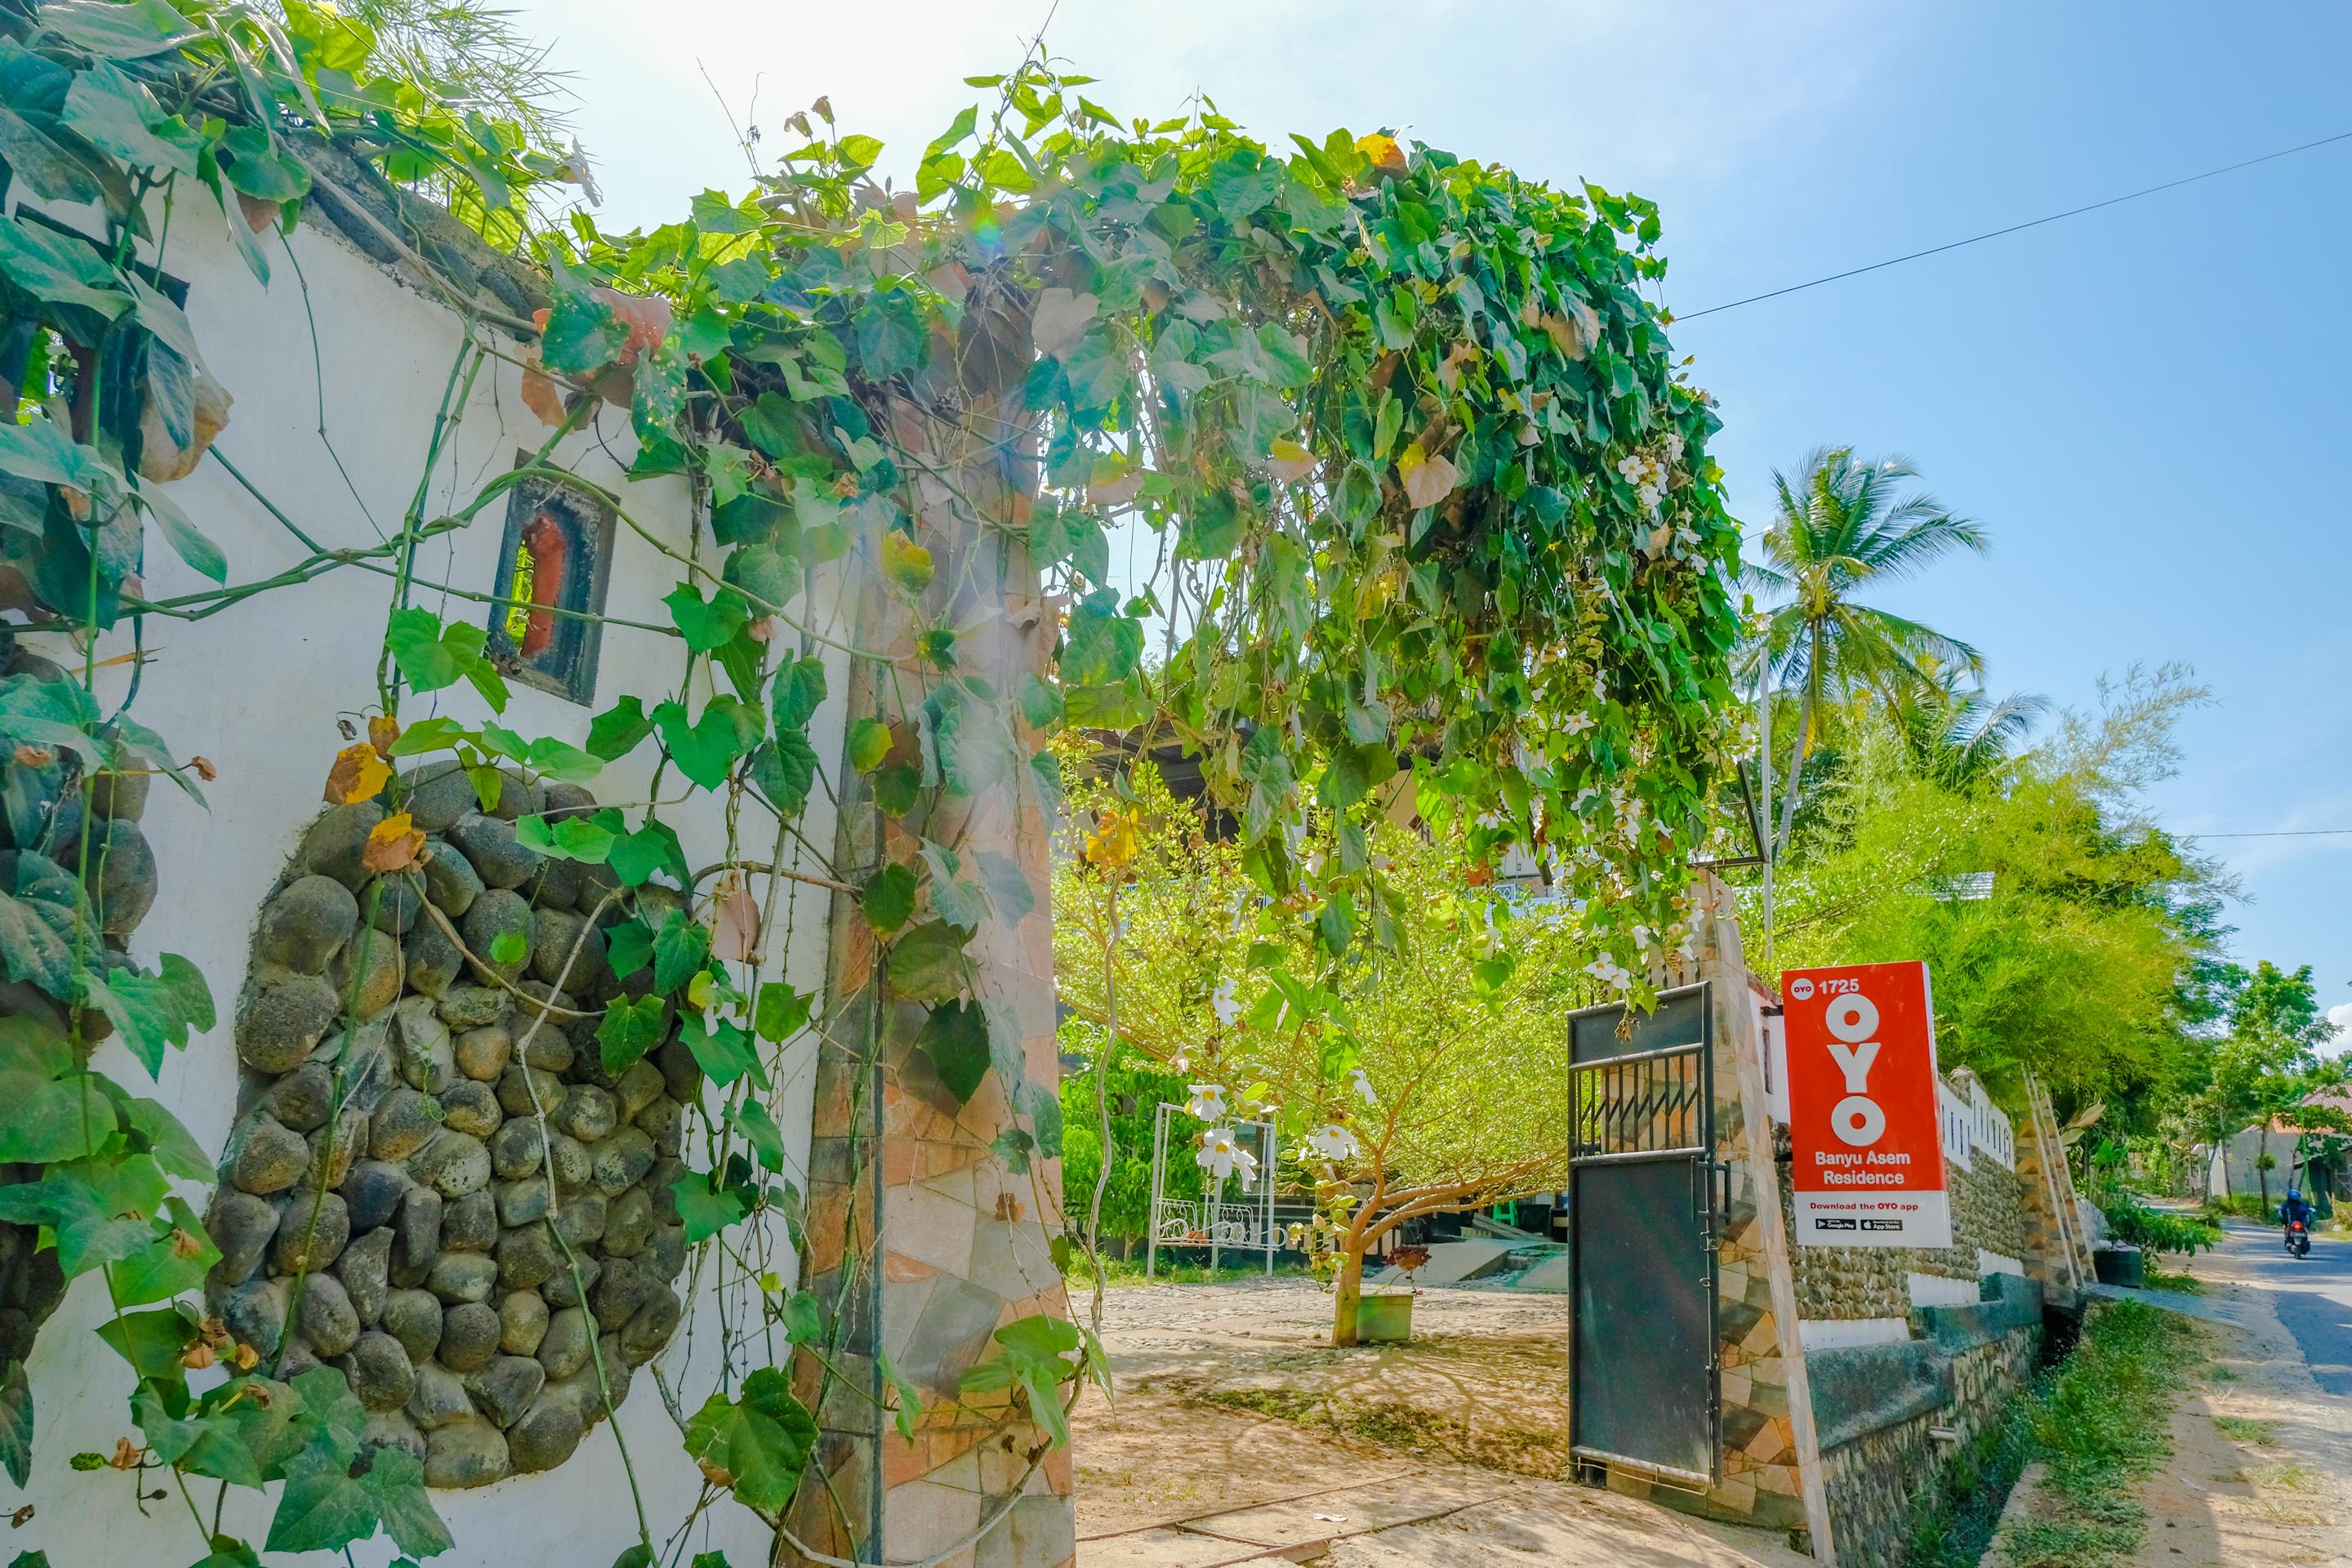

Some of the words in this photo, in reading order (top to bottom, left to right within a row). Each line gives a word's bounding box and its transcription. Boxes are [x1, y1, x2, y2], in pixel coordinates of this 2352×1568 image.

[1819, 978, 1860, 995] 1725
[1825, 993, 1886, 1147] OYO
[1815, 1151, 1862, 1168] Banyu
[1866, 1150, 1910, 1165] Asem
[1823, 1169, 1904, 1185] Residence
[1900, 1203, 1918, 1211] app
